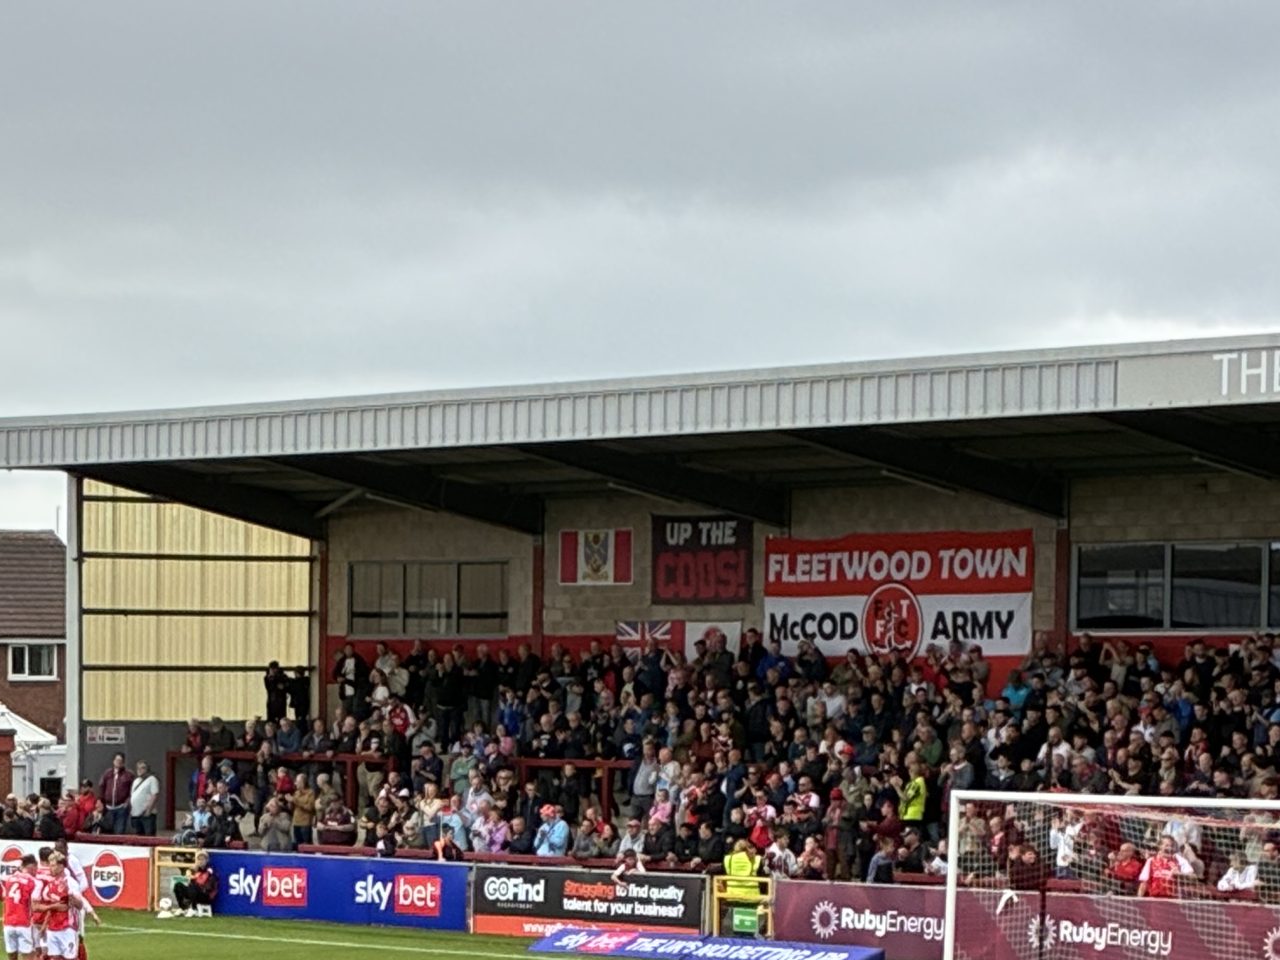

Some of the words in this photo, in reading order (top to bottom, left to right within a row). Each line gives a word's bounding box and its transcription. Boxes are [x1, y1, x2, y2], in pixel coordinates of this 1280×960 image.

[666, 522, 692, 546] UP
[698, 520, 737, 546] THE
[656, 549, 747, 599] CODS!
[768, 550, 931, 583] FLEETWOOD
[938, 547, 1028, 580] TOWN
[769, 612, 859, 642] McCOD
[931, 610, 1016, 641] ARMY
[94, 870, 121, 882] PEPSI
[228, 868, 261, 903] sky
[267, 870, 303, 898] bet
[563, 879, 615, 899] Struggling
[615, 884, 628, 897] to
[629, 884, 648, 898] find
[649, 885, 685, 902] quality
[355, 874, 393, 911] sky
[399, 878, 436, 908] bet
[563, 899, 593, 912] talent
[593, 900, 610, 913] for
[610, 902, 634, 917] your
[634, 902, 685, 918] business?
[840, 907, 945, 940] RubyEnergy
[1059, 919, 1172, 955] RubyEnergy
[625, 938, 667, 953] THE
